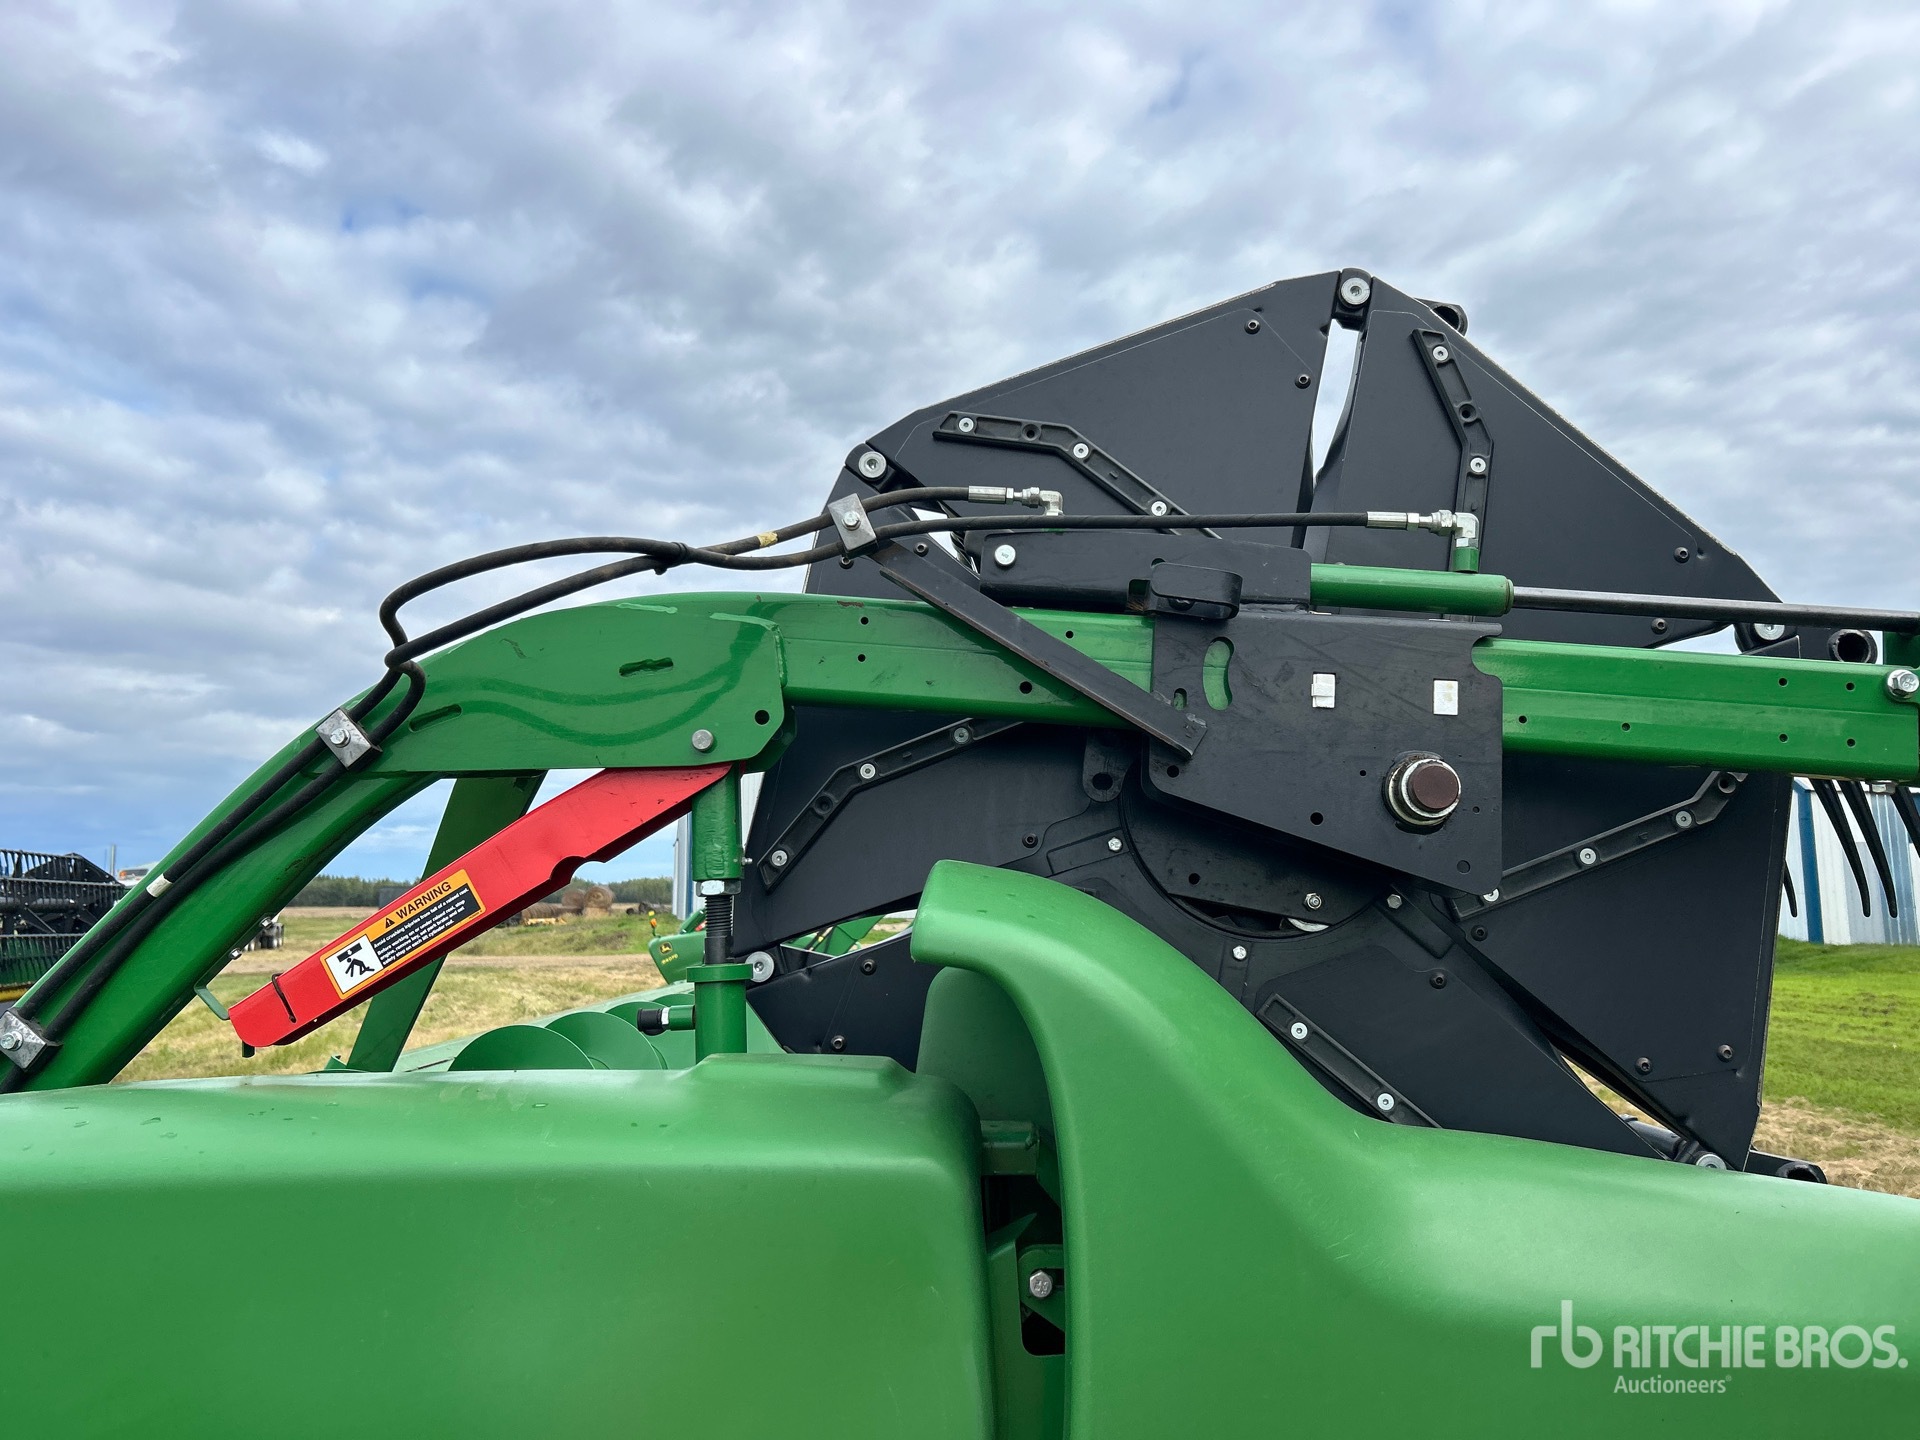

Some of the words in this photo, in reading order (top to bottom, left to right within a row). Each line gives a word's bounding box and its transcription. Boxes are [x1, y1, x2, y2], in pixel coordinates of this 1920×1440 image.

[396, 882, 451, 919] WARNING
[386, 927, 405, 940] crushing
[404, 918, 420, 929] injuries
[391, 935, 409, 946] working
